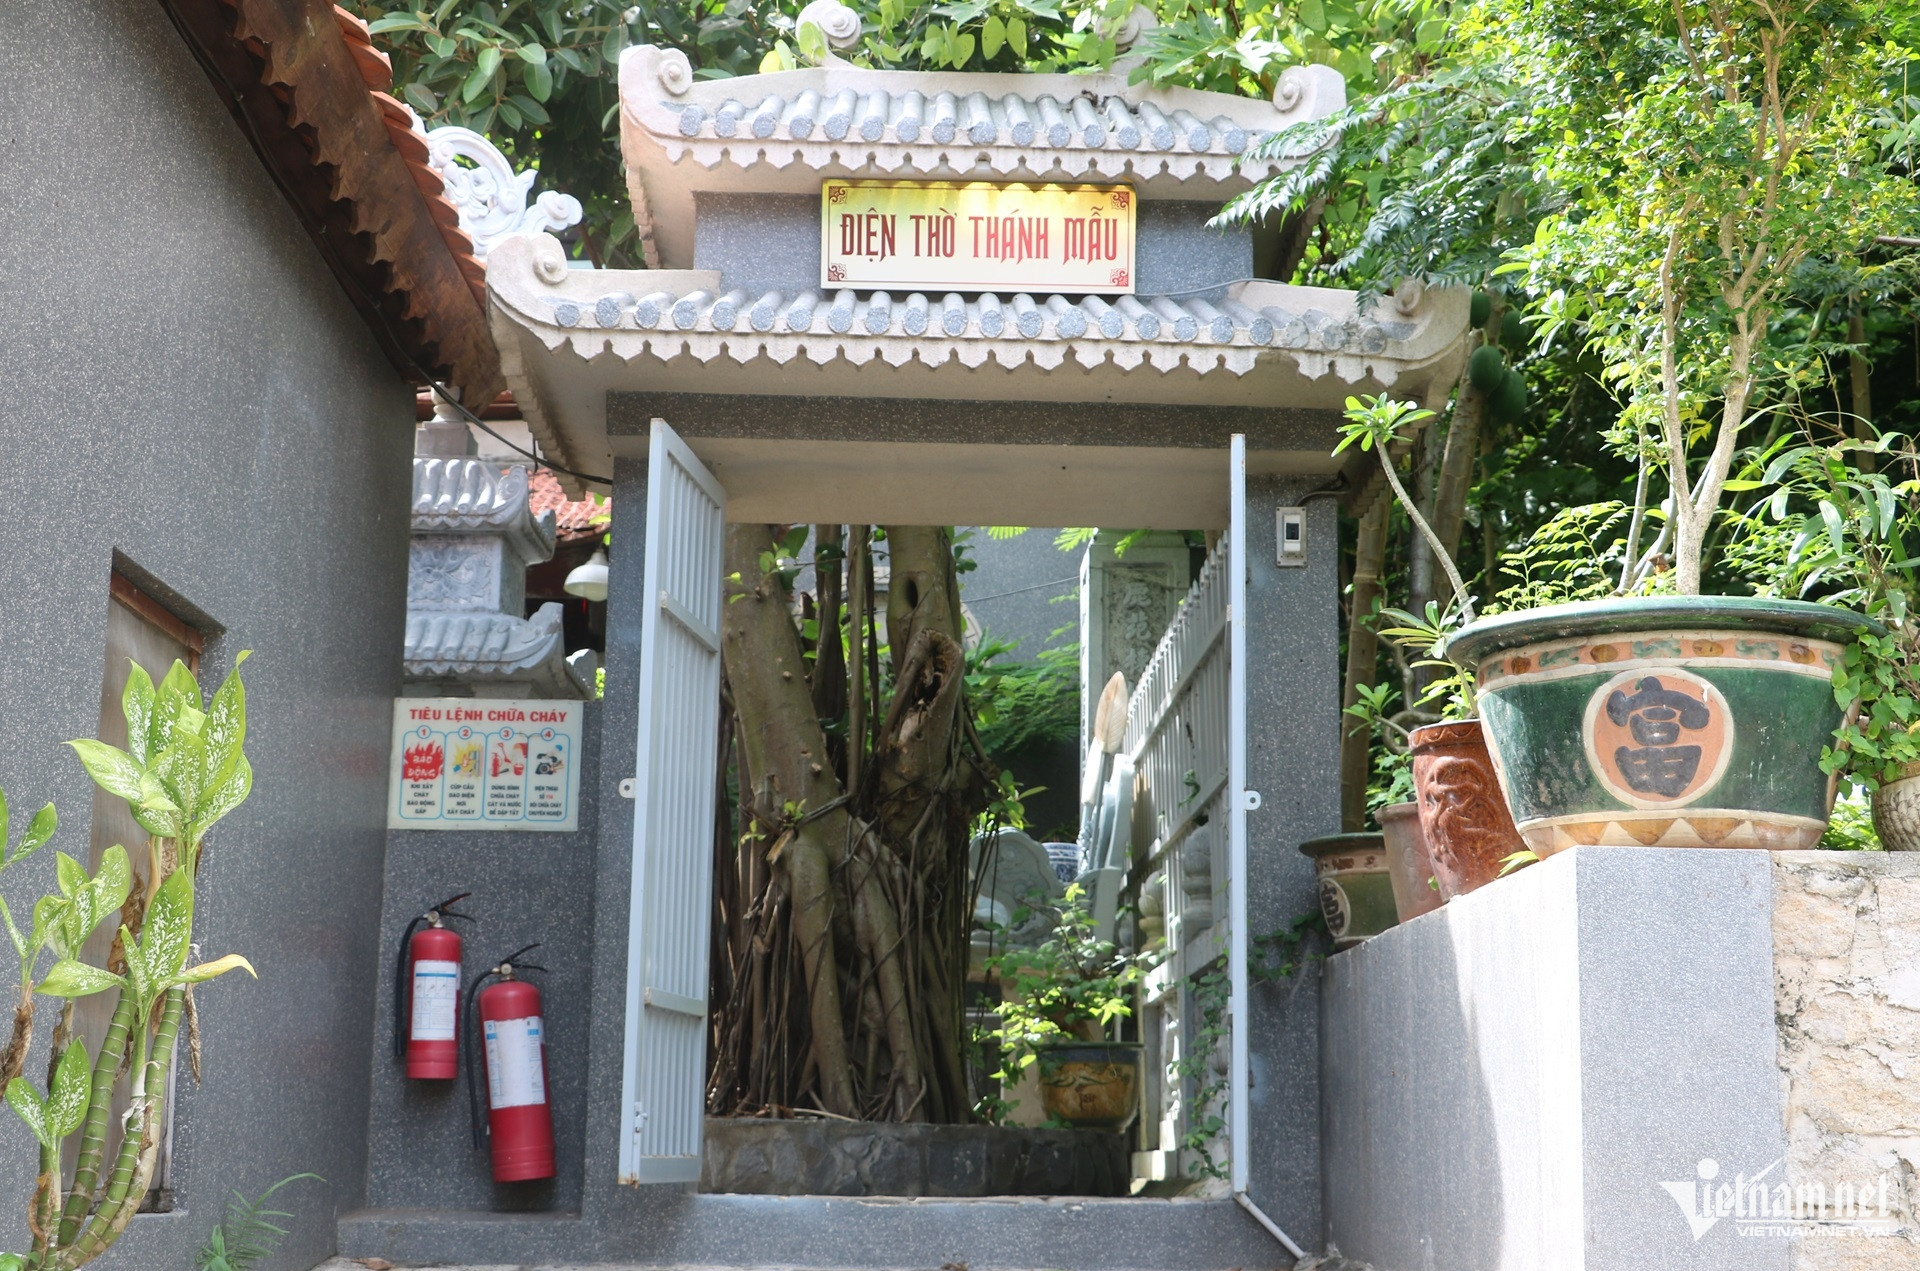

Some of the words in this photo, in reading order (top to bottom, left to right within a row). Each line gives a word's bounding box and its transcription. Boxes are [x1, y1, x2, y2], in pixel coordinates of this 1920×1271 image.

[840, 206, 897, 263] ĐIỆN
[909, 206, 958, 258] THỜ
[968, 208, 1049, 265] THÁNH
[1061, 205, 1119, 265] MẪU
[409, 706, 442, 721] TIÊU
[445, 706, 483, 724] LỆNH
[487, 707, 526, 722] CHỮA
[529, 707, 568, 723] CHÁY
[462, 729, 469, 737] 2
[503, 730, 510, 738] 3
[544, 730, 552, 738] 4
